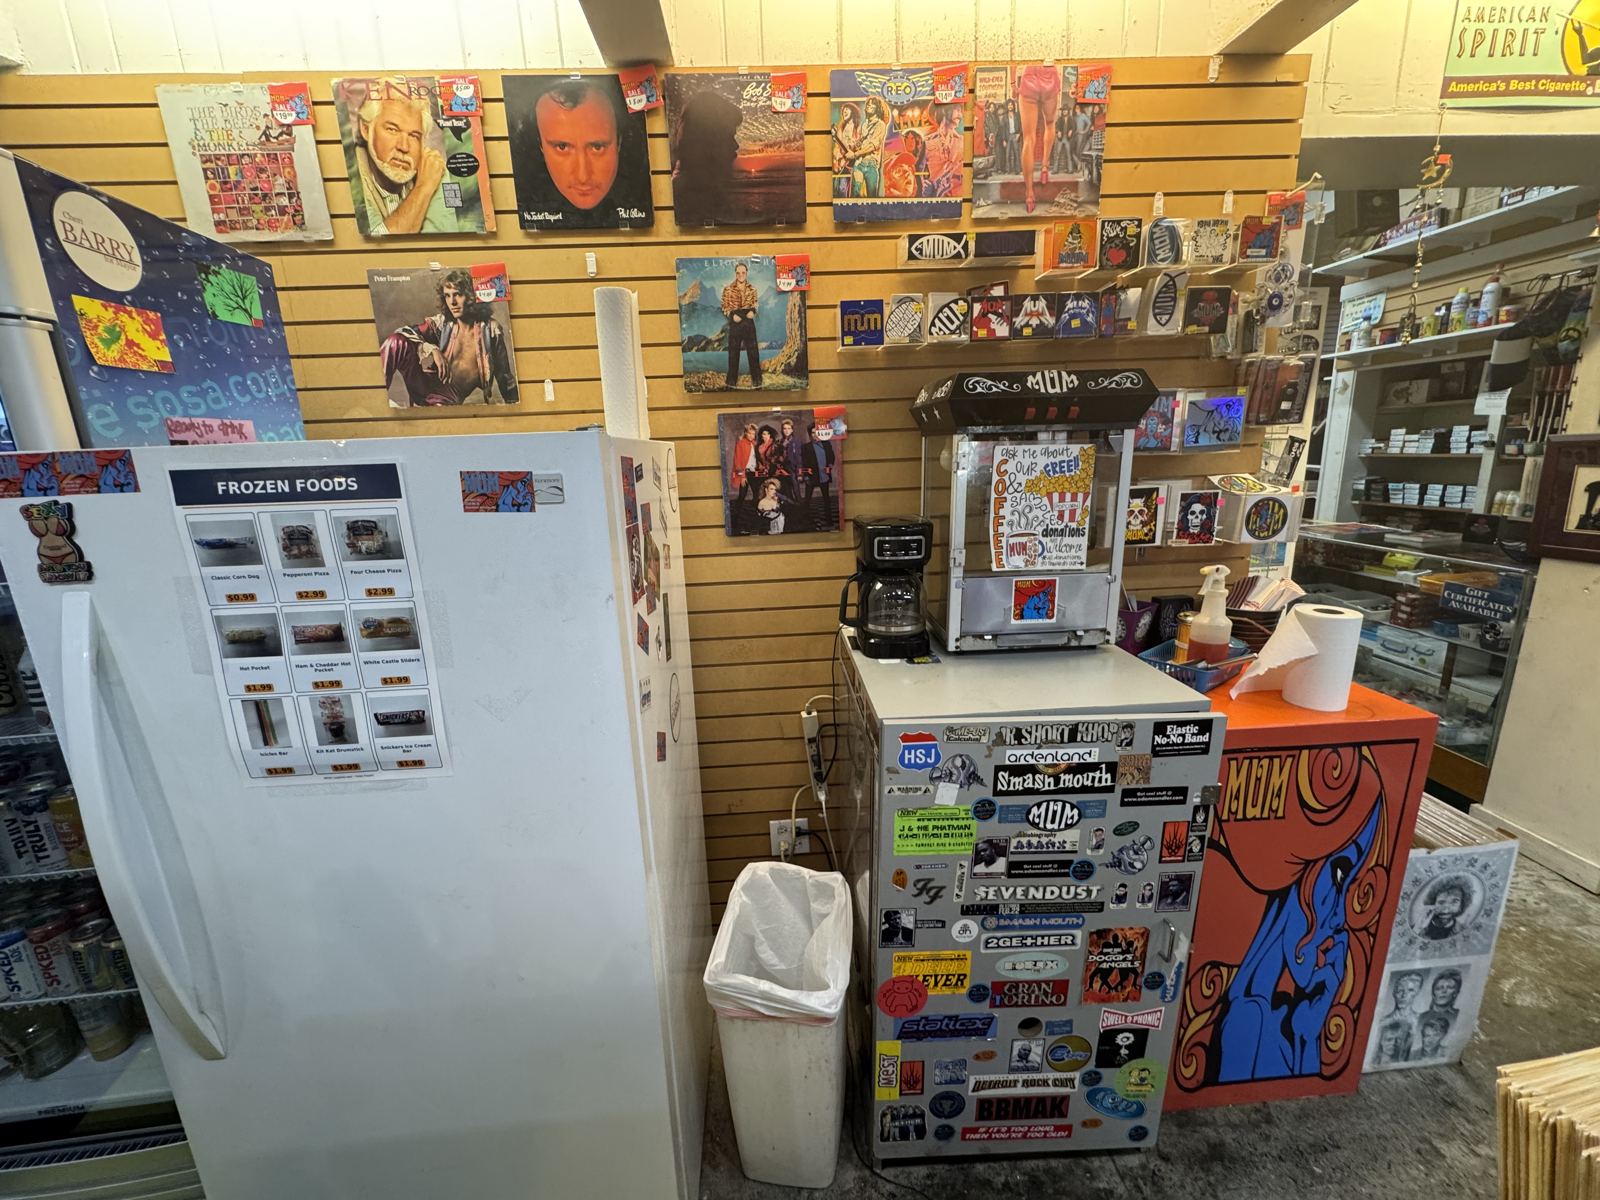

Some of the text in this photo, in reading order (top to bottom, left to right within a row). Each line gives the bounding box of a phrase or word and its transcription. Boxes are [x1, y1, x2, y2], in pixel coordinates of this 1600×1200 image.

[1461, 6, 1551, 24] AMERICAN
[1457, 27, 1546, 58] SPIRIT
[1448, 80, 1506, 92] America's
[1509, 80, 1535, 90] Best
[205, 129, 235, 141] THE
[59, 219, 135, 265] BARRY
[922, 237, 954, 258] MUM
[1027, 370, 1079, 393] MUM
[1001, 445, 1073, 459] ask about
[1043, 454, 1080, 477] FREE!!
[217, 477, 358, 495] FROZEN FOODS
[1007, 472, 1023, 495] &
[993, 458, 1010, 569] COFFEE
[1041, 525, 1086, 539] donations
[247, 573, 260, 581] Dog
[227, 592, 255, 602] $0.99
[298, 590, 325, 599] $2.99
[366, 588, 393, 596] $2.99
[1448, 599, 1503, 619] AVAILABLE
[314, 681, 340, 689] $1.99
[382, 676, 408, 684] $1.99
[246, 684, 272, 692] $1.99
[1021, 723, 1073, 745] SHORT
[1166, 724, 1199, 735] Elastic
[1153, 732, 1209, 745] No-No Band
[905, 748, 935, 764] HSJ
[1008, 750, 1091, 763] ardenland
[997, 764, 1112, 792] Smash mouth
[1222, 756, 1296, 822] MUM
[1028, 801, 1079, 830] MUM
[932, 824, 971, 832] PHATMAN
[22, 819, 51, 863] TRULY
[974, 885, 1100, 901] SEVENDUST
[998, 916, 1083, 925] SMASH MOUTH
[1100, 961, 1141, 969] ANGELS
[1003, 982, 1053, 994] GRAN
[1102, 1011, 1161, 1027] SWELL PHONIC
[971, 1080, 1019, 1093] DETROIT
[1021, 1078, 1050, 1088] ROCK
[977, 1096, 1065, 1120] BBMAK
